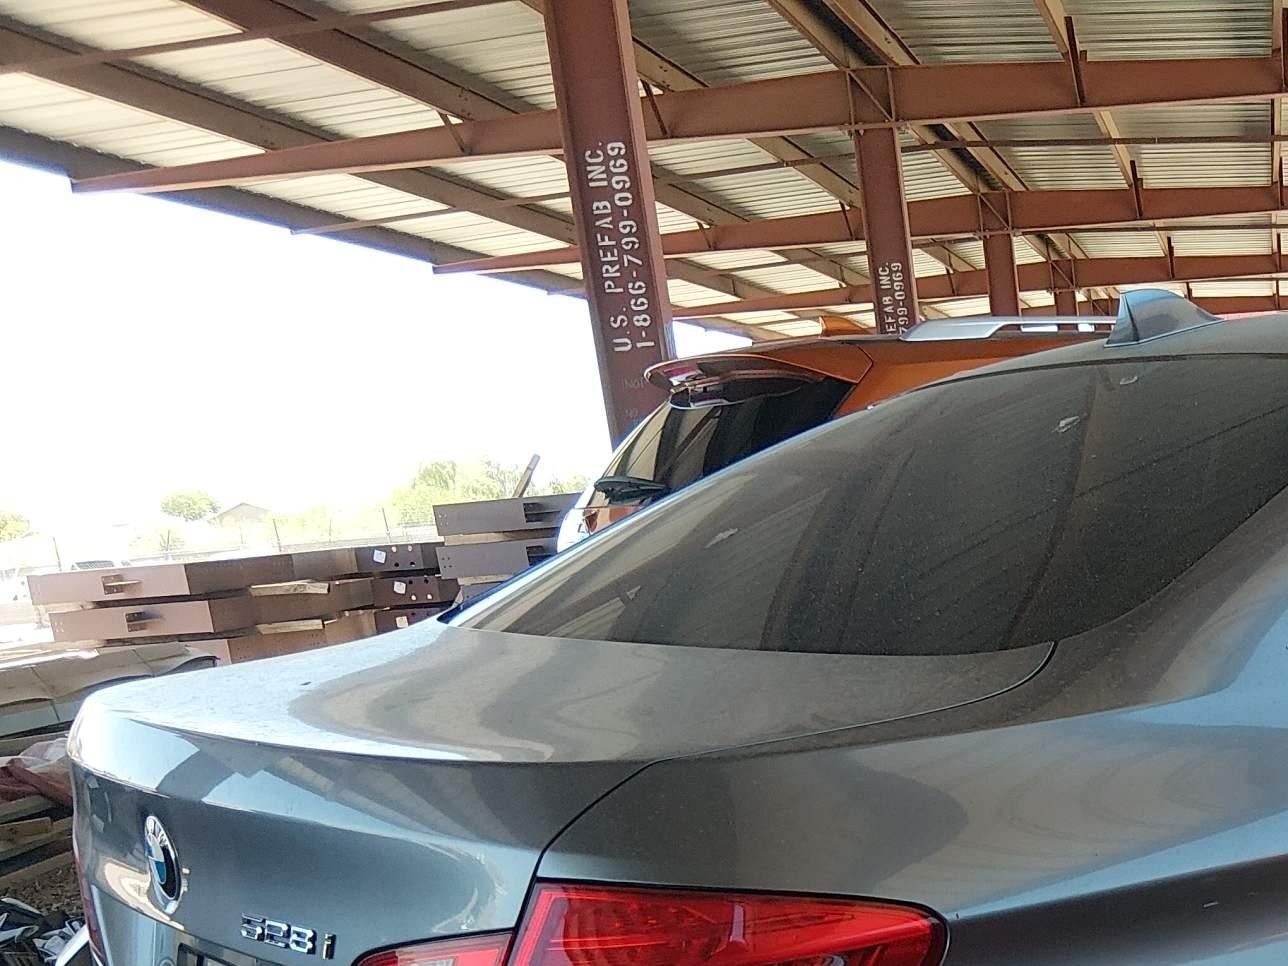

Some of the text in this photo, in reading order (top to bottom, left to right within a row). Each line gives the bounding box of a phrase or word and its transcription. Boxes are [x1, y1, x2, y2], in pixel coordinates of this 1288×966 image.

[584, 142, 632, 352] U.S. PREFAB INC.
[606, 142, 655, 348] 1-866-799-0969
[878, 262, 897, 336] EFAB INC.
